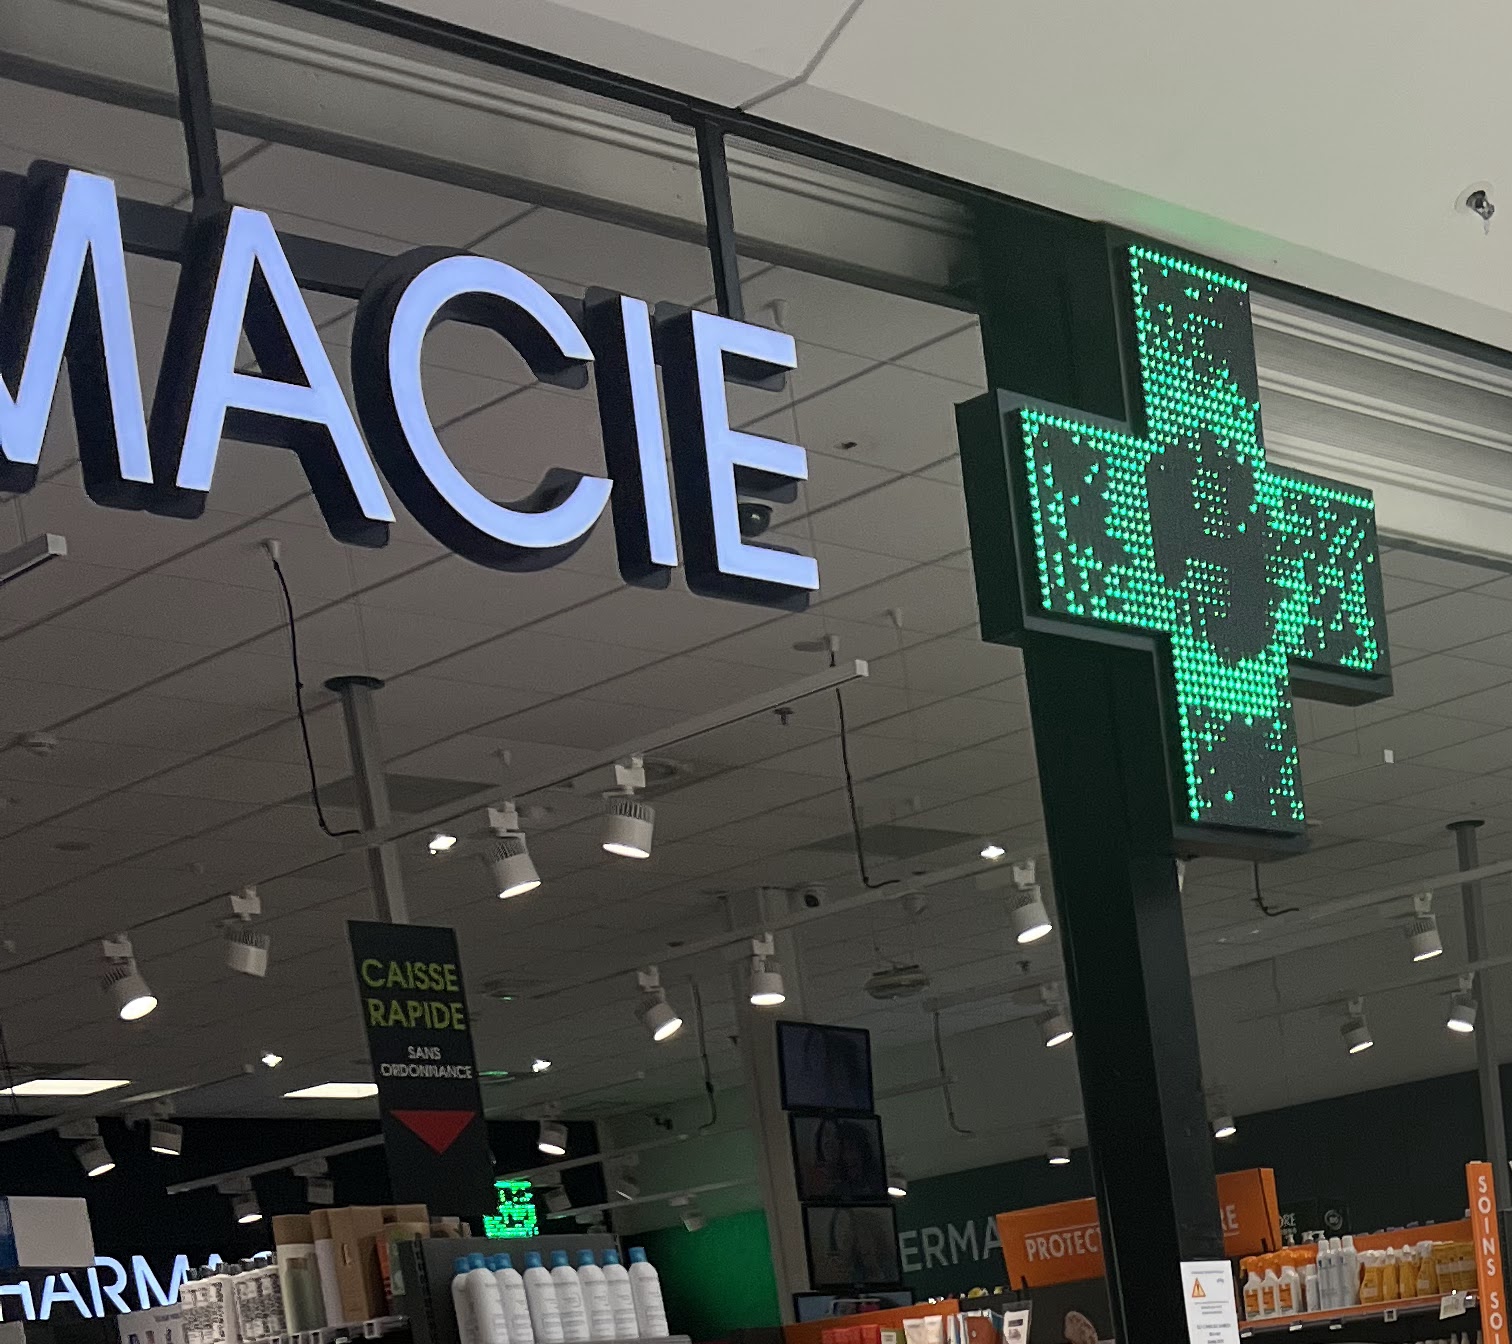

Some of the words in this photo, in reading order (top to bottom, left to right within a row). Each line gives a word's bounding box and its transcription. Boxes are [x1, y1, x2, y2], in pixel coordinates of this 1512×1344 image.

[0, 168, 820, 591] MACIE
[361, 959, 459, 992] CAISSE
[367, 998, 466, 1030] RAPIDE
[407, 1045, 441, 1060] SANS
[380, 1063, 472, 1079] ORDONNANCE
[1478, 1175, 1496, 1277] SOINS
